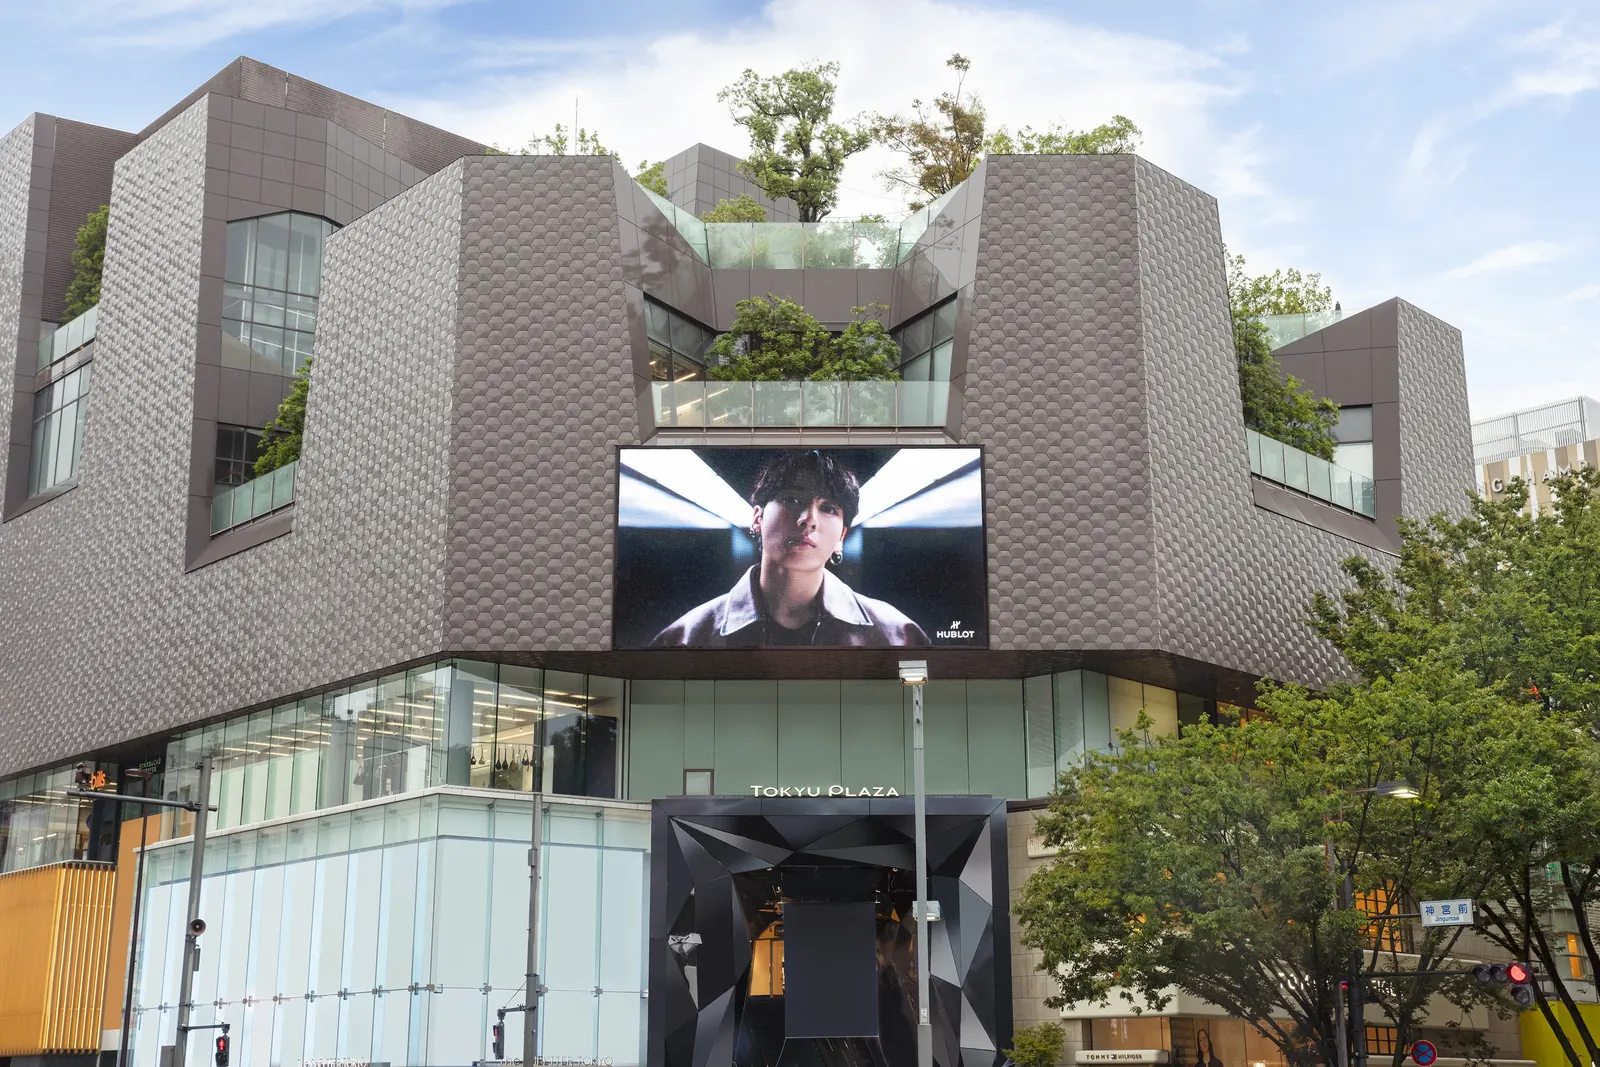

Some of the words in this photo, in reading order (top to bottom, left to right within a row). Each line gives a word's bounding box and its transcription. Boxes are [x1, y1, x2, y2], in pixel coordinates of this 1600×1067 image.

[936, 630, 975, 639] HUBLOT
[750, 785, 821, 797] TOKYU
[828, 785, 899, 797] PLAZA
[1425, 903, 1467, 915] 神宮前
